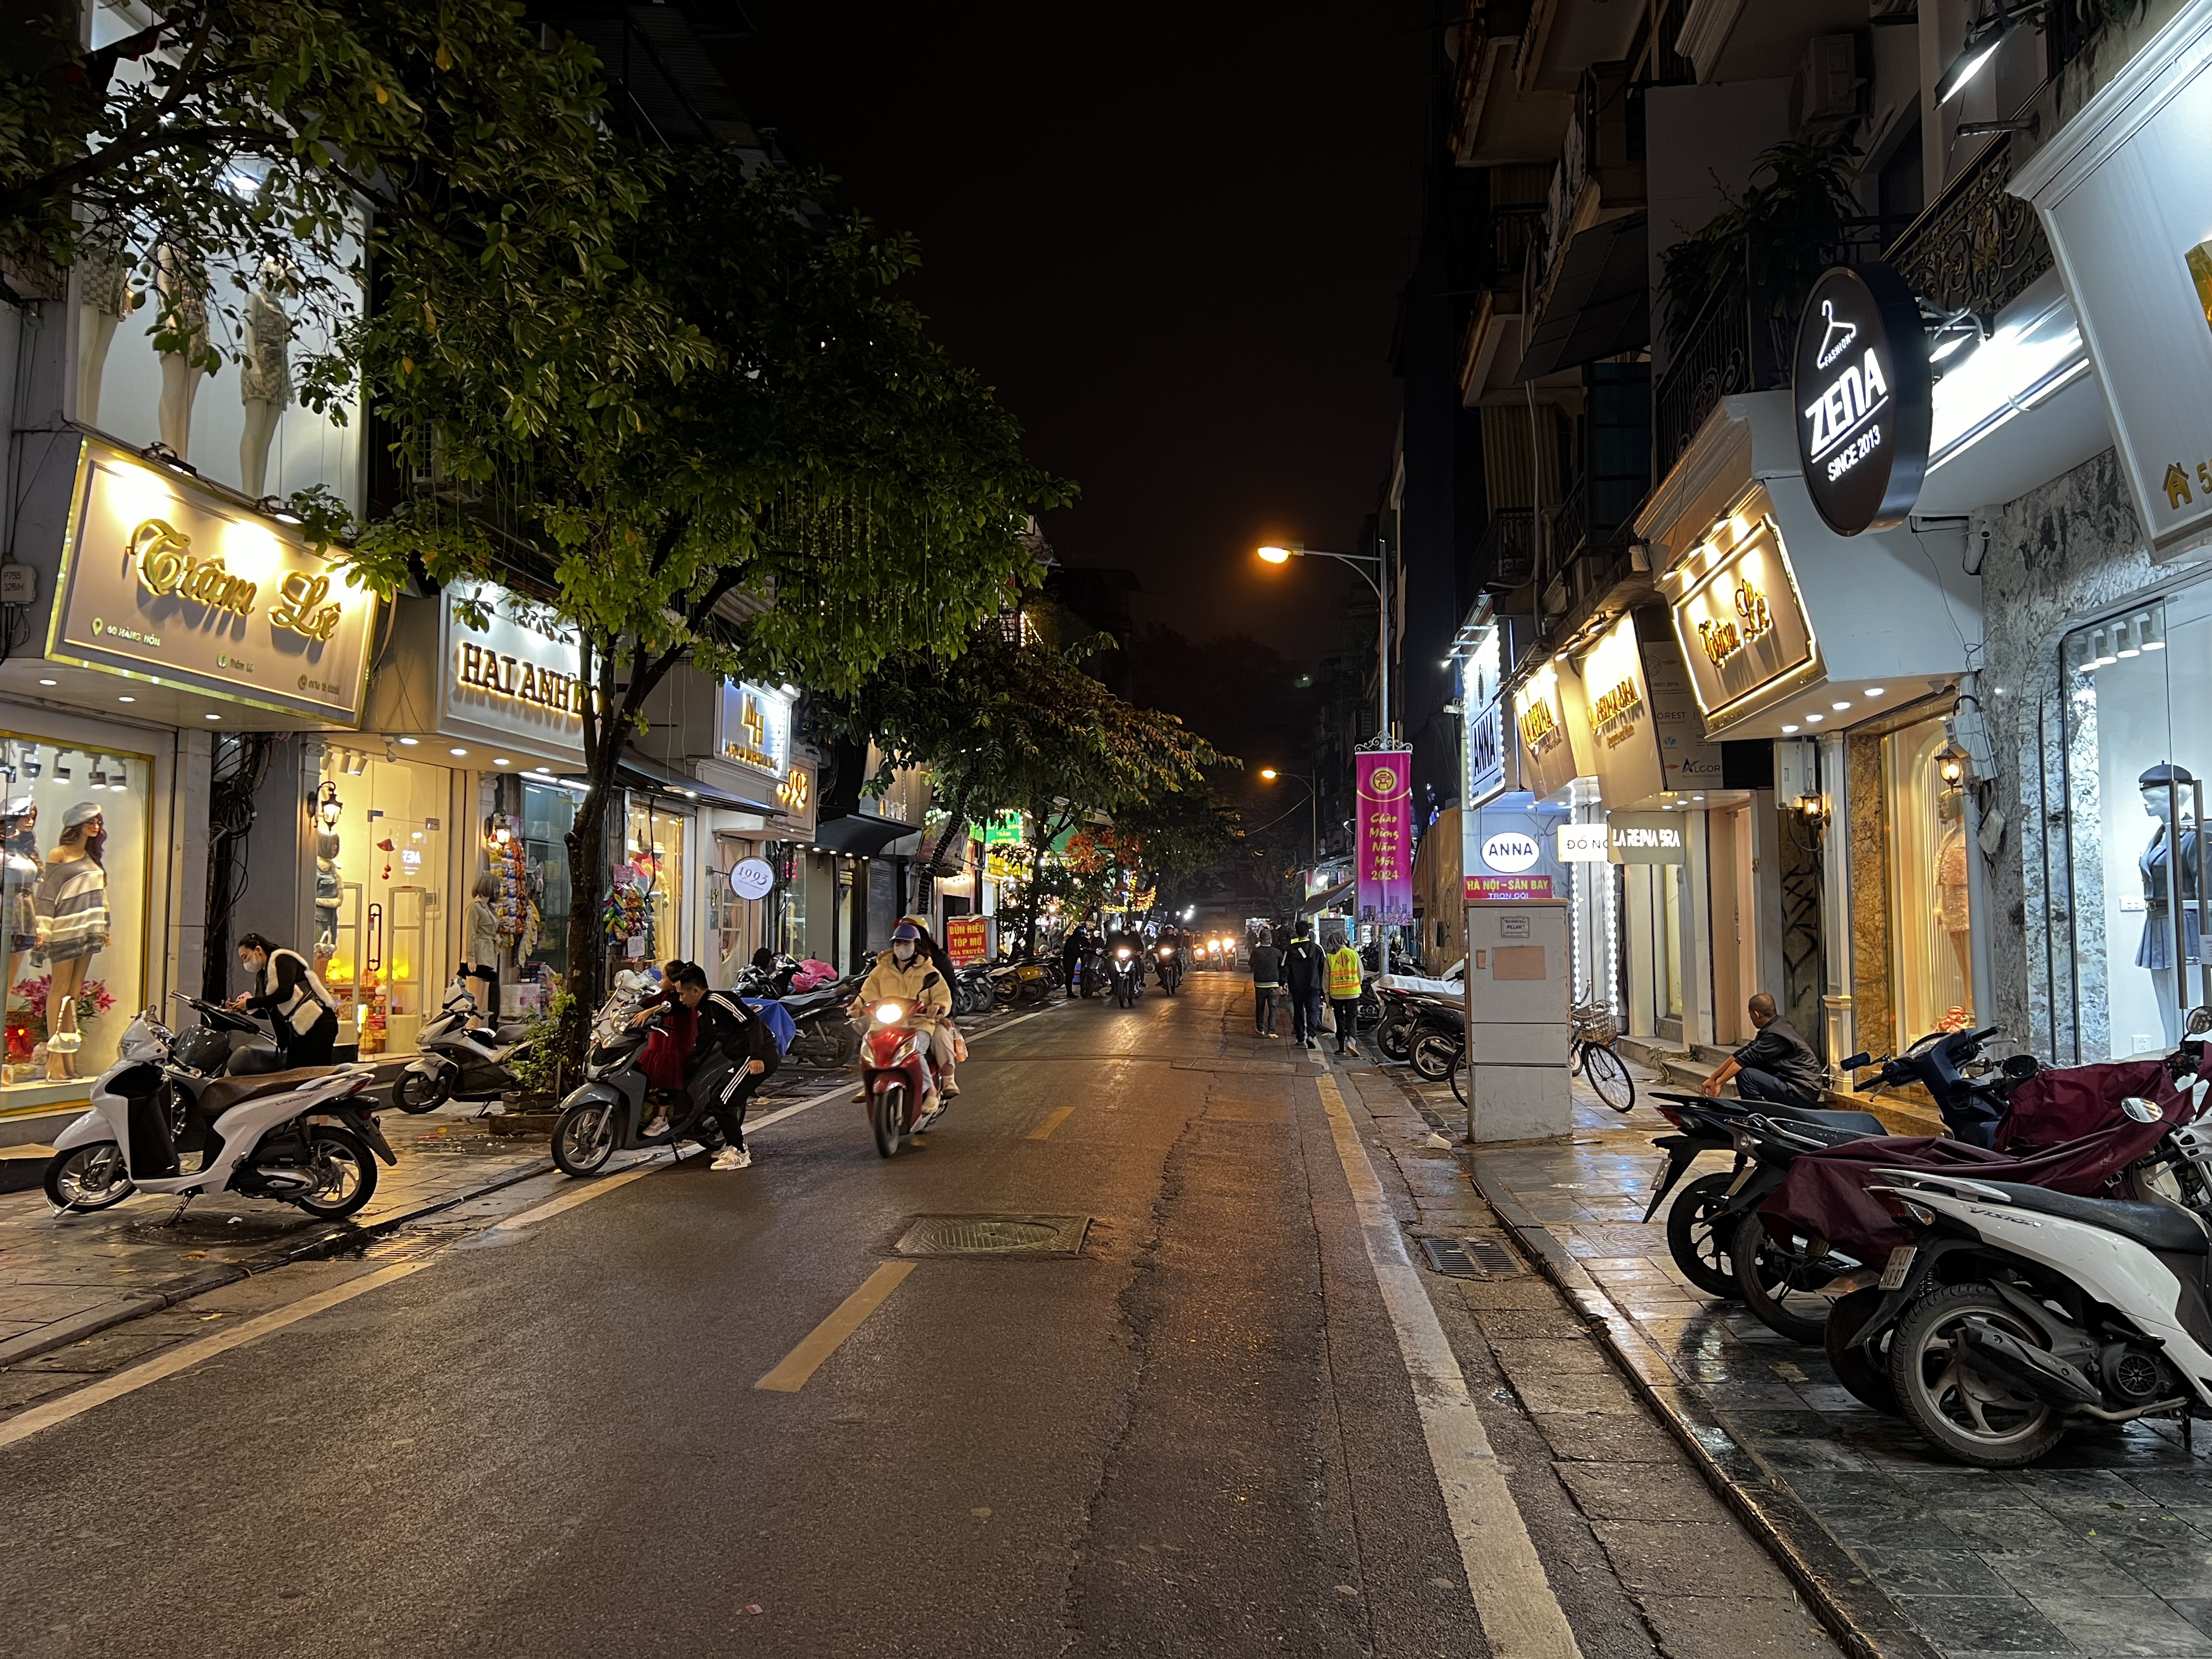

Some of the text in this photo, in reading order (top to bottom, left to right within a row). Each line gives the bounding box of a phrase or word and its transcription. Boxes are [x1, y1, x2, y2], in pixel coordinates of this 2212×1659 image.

[1824, 333, 1851, 366] FASHION
[1805, 347, 1887, 456] ZENA
[1828, 424, 1880, 482] SINCE 2013
[2196, 458, 2212, 495] 5
[3, 571, 21, 580] P755
[107, 625, 117, 635] 60
[118, 627, 141, 641] HÀNG
[1474, 712, 1496, 777] ANNA
[1682, 758, 1721, 773] ALCOR
[1370, 812, 1397, 824] Chào
[1369, 827, 1399, 841] Mừng
[1613, 828, 1626, 847] LA
[1373, 841, 1396, 852] Năm
[1489, 843, 1533, 856] ANNA
[1374, 855, 1395, 867] Mới
[738, 867, 769, 885] 1993
[1371, 870, 1399, 880] 2024
[1467, 878, 1548, 893] HÀ NỘI SÂN BAY
[950, 922, 984, 935] BÚN RIÊU
